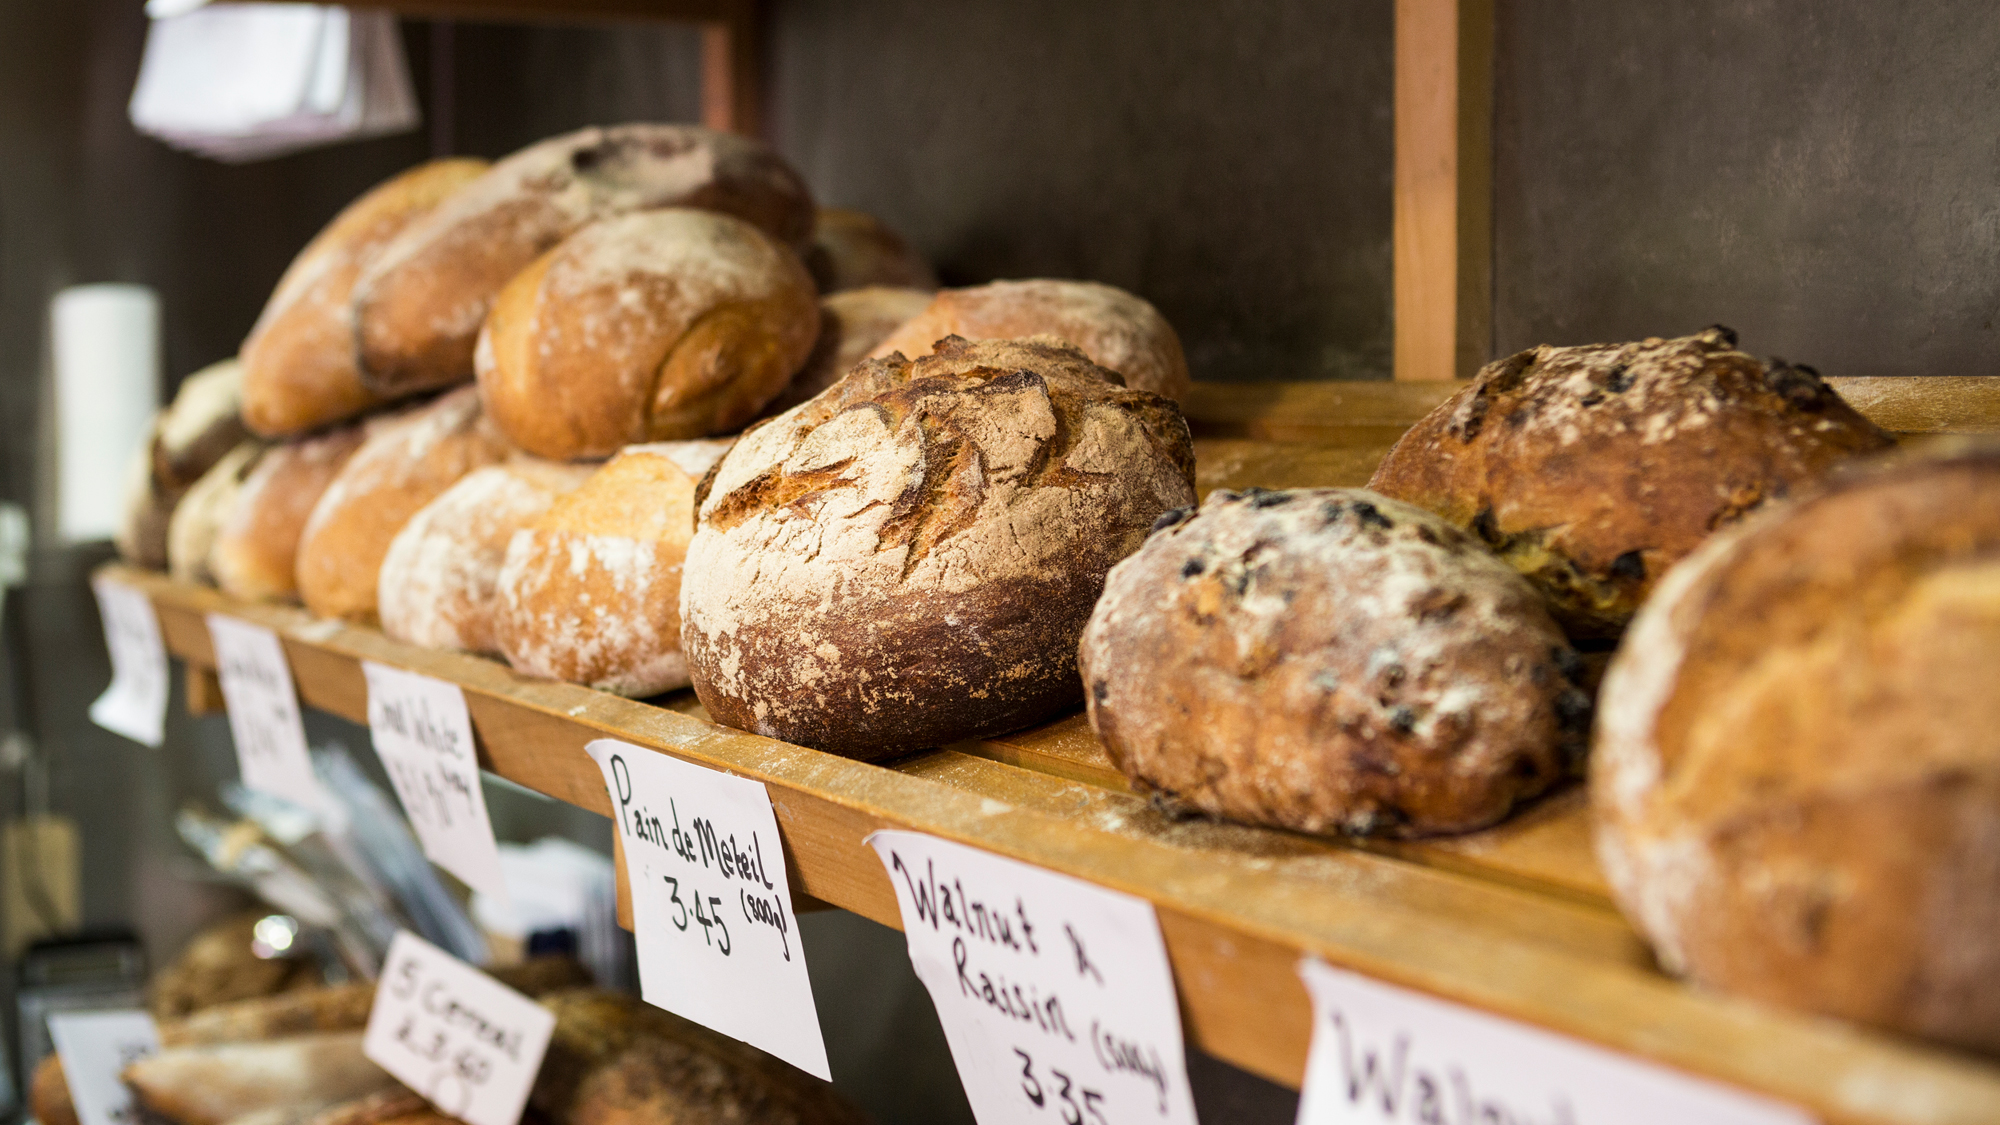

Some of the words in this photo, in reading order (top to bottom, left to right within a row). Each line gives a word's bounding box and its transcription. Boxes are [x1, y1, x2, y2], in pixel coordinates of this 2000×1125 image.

[610, 754, 669, 851] Pain
[671, 797, 697, 863] de
[664, 876, 731, 957] 3.45
[740, 887, 790, 962] (800g)
[891, 850, 1038, 955] Walnut
[953, 937, 1075, 1041] Raisin
